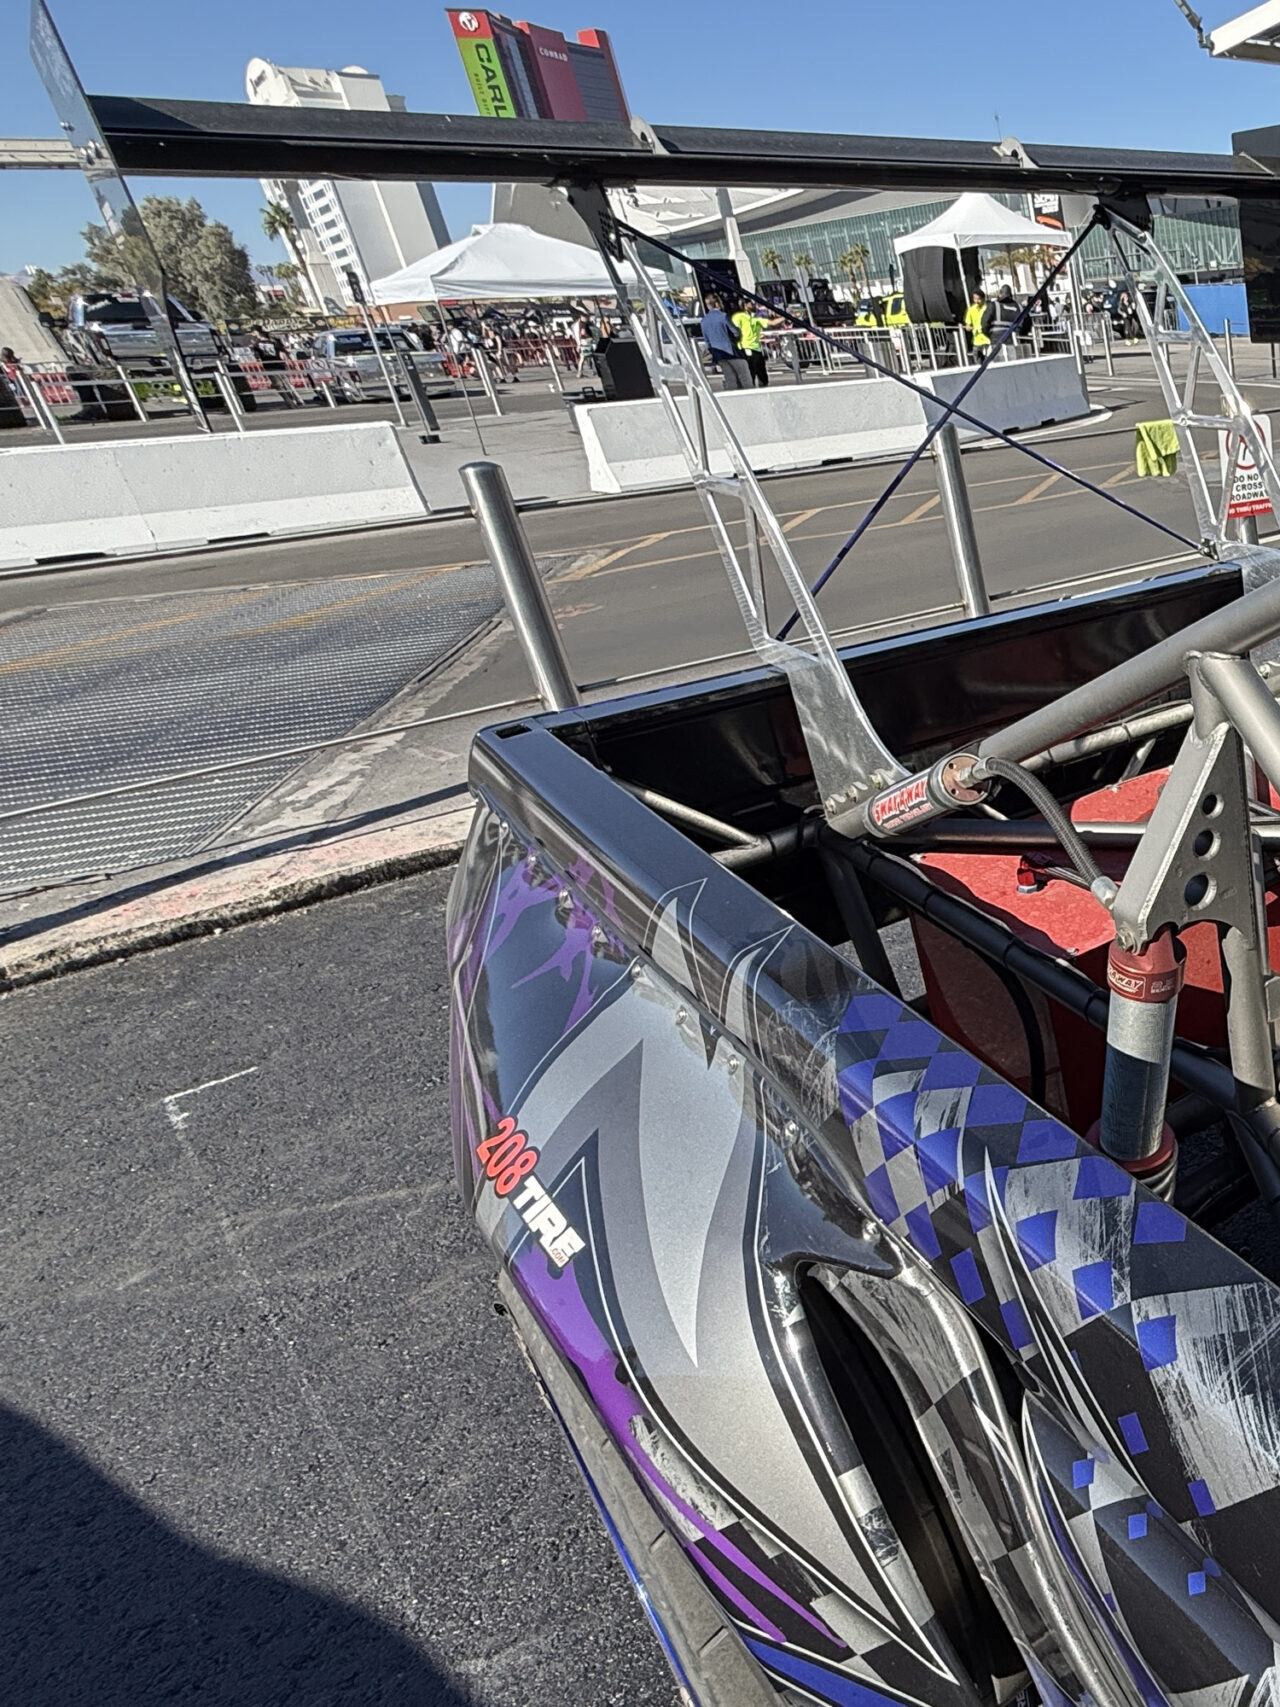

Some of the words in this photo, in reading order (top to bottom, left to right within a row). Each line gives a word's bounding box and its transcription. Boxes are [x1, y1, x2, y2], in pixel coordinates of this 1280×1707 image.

[474, 43, 507, 117] CARL
[1231, 490, 1265, 501] ROADWA
[1235, 482, 1263, 492] CROSS
[477, 1117, 538, 1195] 208
[513, 1175, 586, 1258] TIRE
